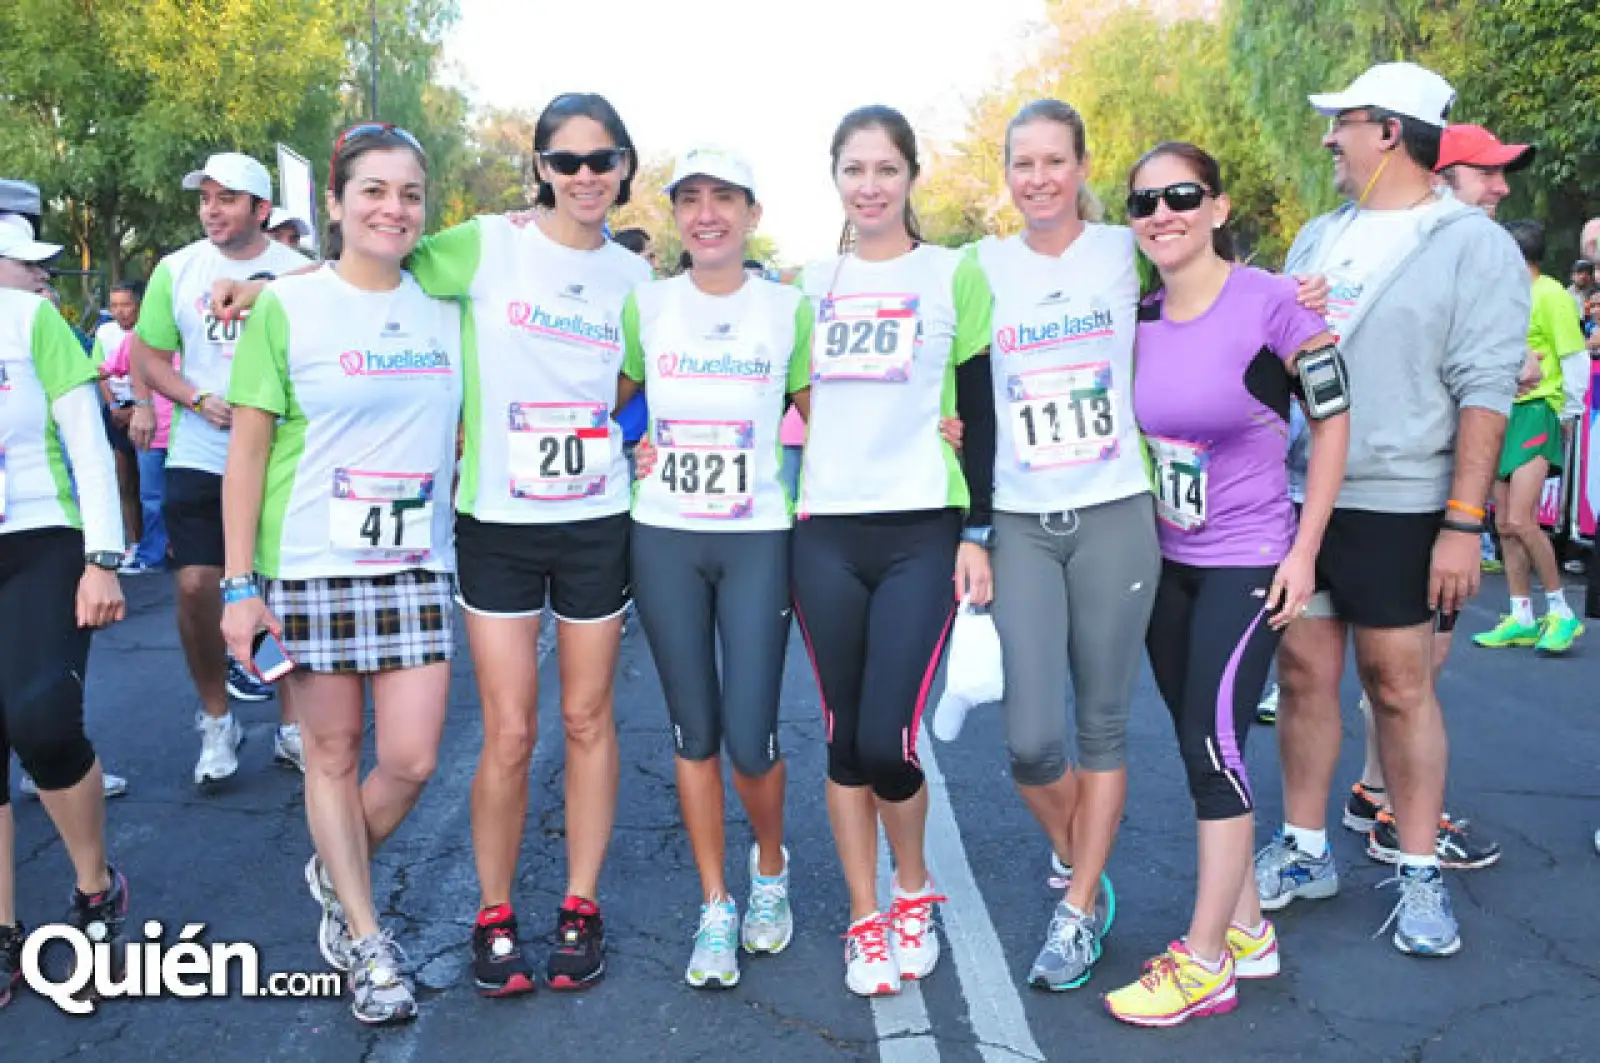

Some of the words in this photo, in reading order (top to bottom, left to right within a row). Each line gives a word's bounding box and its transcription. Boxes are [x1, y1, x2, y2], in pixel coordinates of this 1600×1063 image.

[825, 319, 899, 357] 926
[1020, 398, 1113, 446] 1113
[540, 435, 584, 478] 20
[661, 452, 746, 494] 4321
[360, 505, 404, 547] 41
